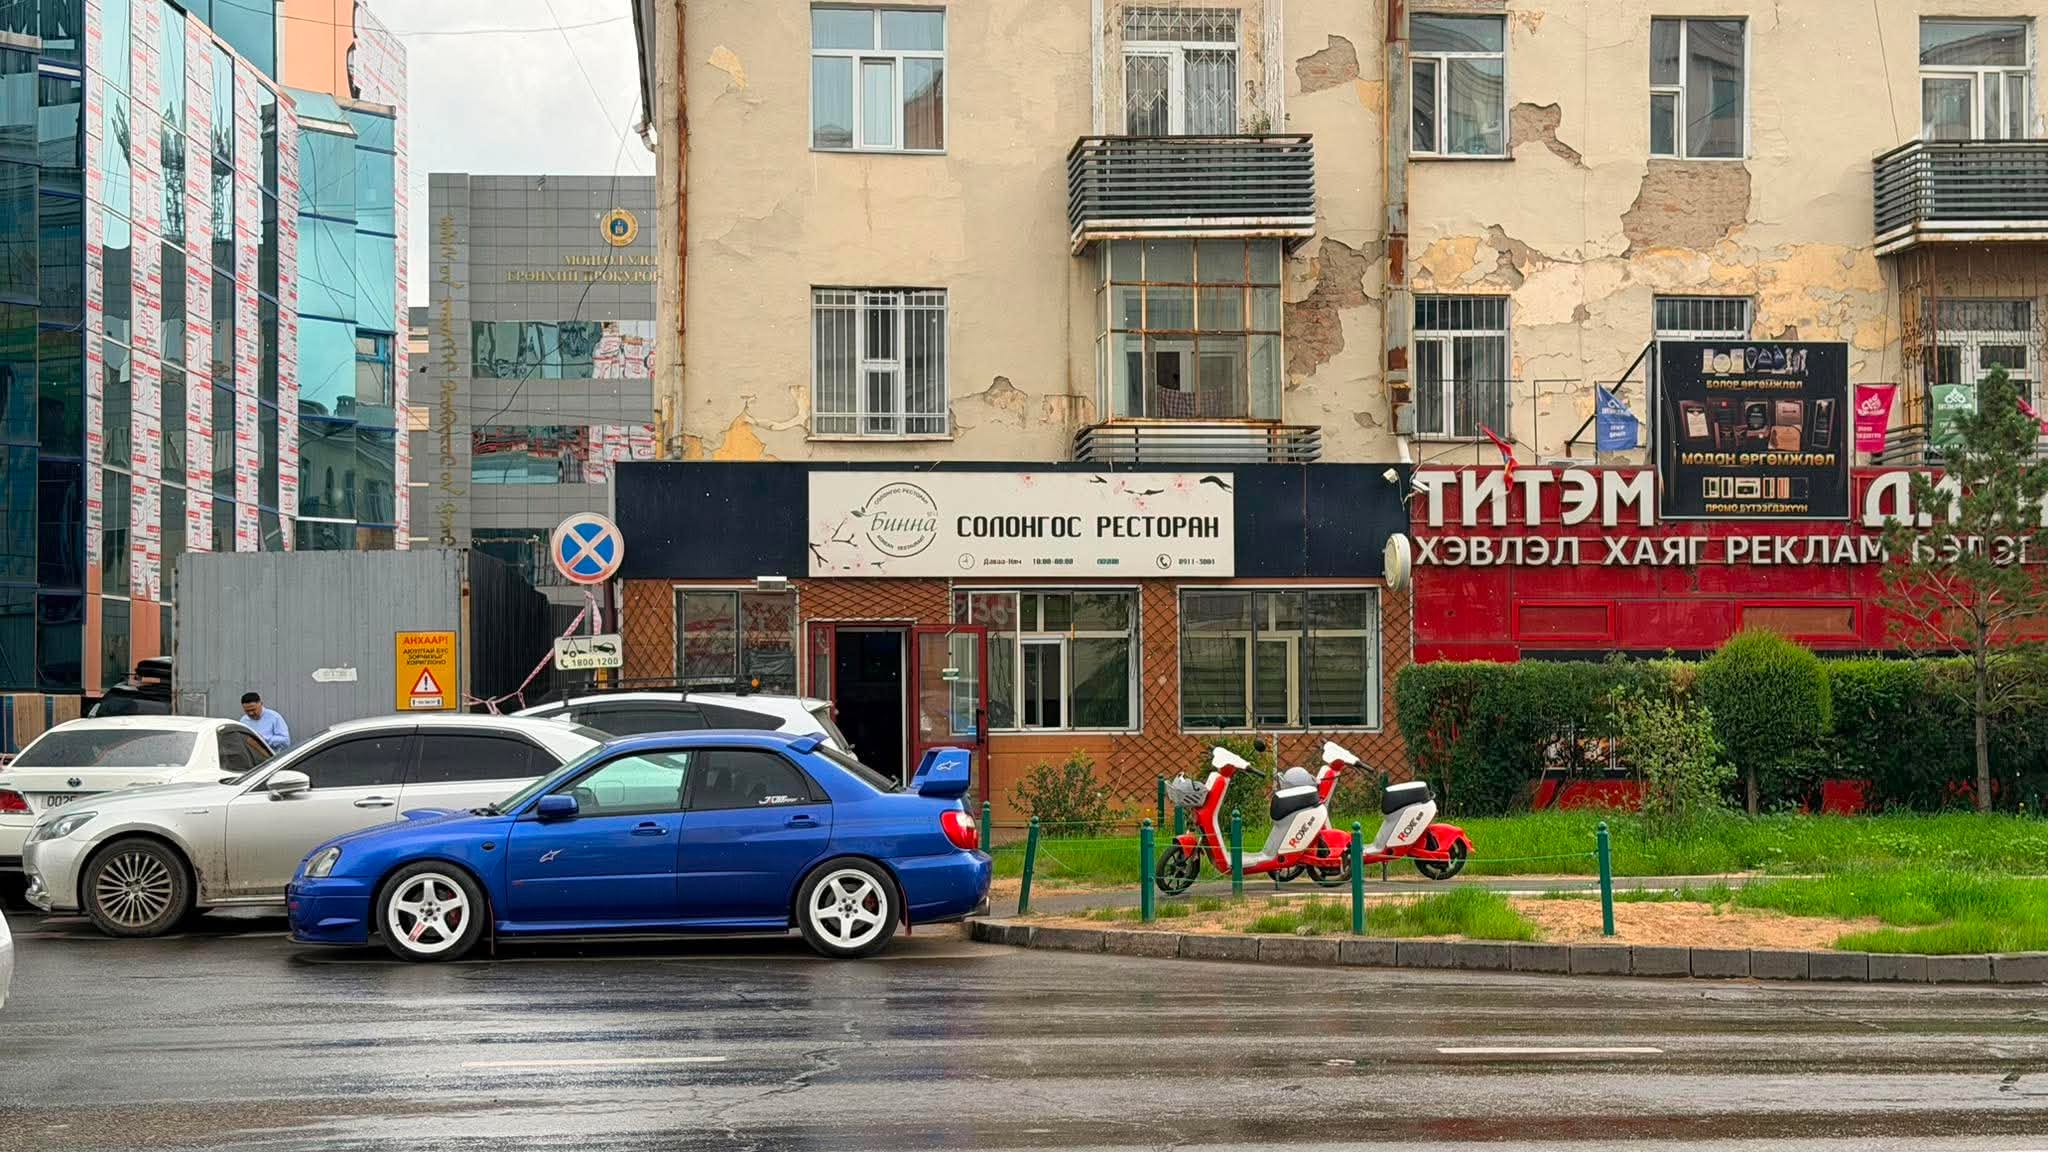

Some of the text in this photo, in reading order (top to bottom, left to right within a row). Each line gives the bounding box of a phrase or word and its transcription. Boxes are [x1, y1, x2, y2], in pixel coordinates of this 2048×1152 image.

[1681, 453, 1835, 466] МОДОН ӨРГӨМЖЛӨЛ
[1417, 470, 1655, 527] ТИТЭМ
[870, 511, 937, 532] Бинна
[957, 516, 1219, 538] СОЛОНГОС РЕСТОРАН
[1415, 536, 1580, 566] ХЭВЛЭЛ
[1603, 536, 1708, 566] ХАЯГ
[1727, 535, 1889, 565] РЕКЛАМ
[572, 657, 619, 666] 1800 1200
